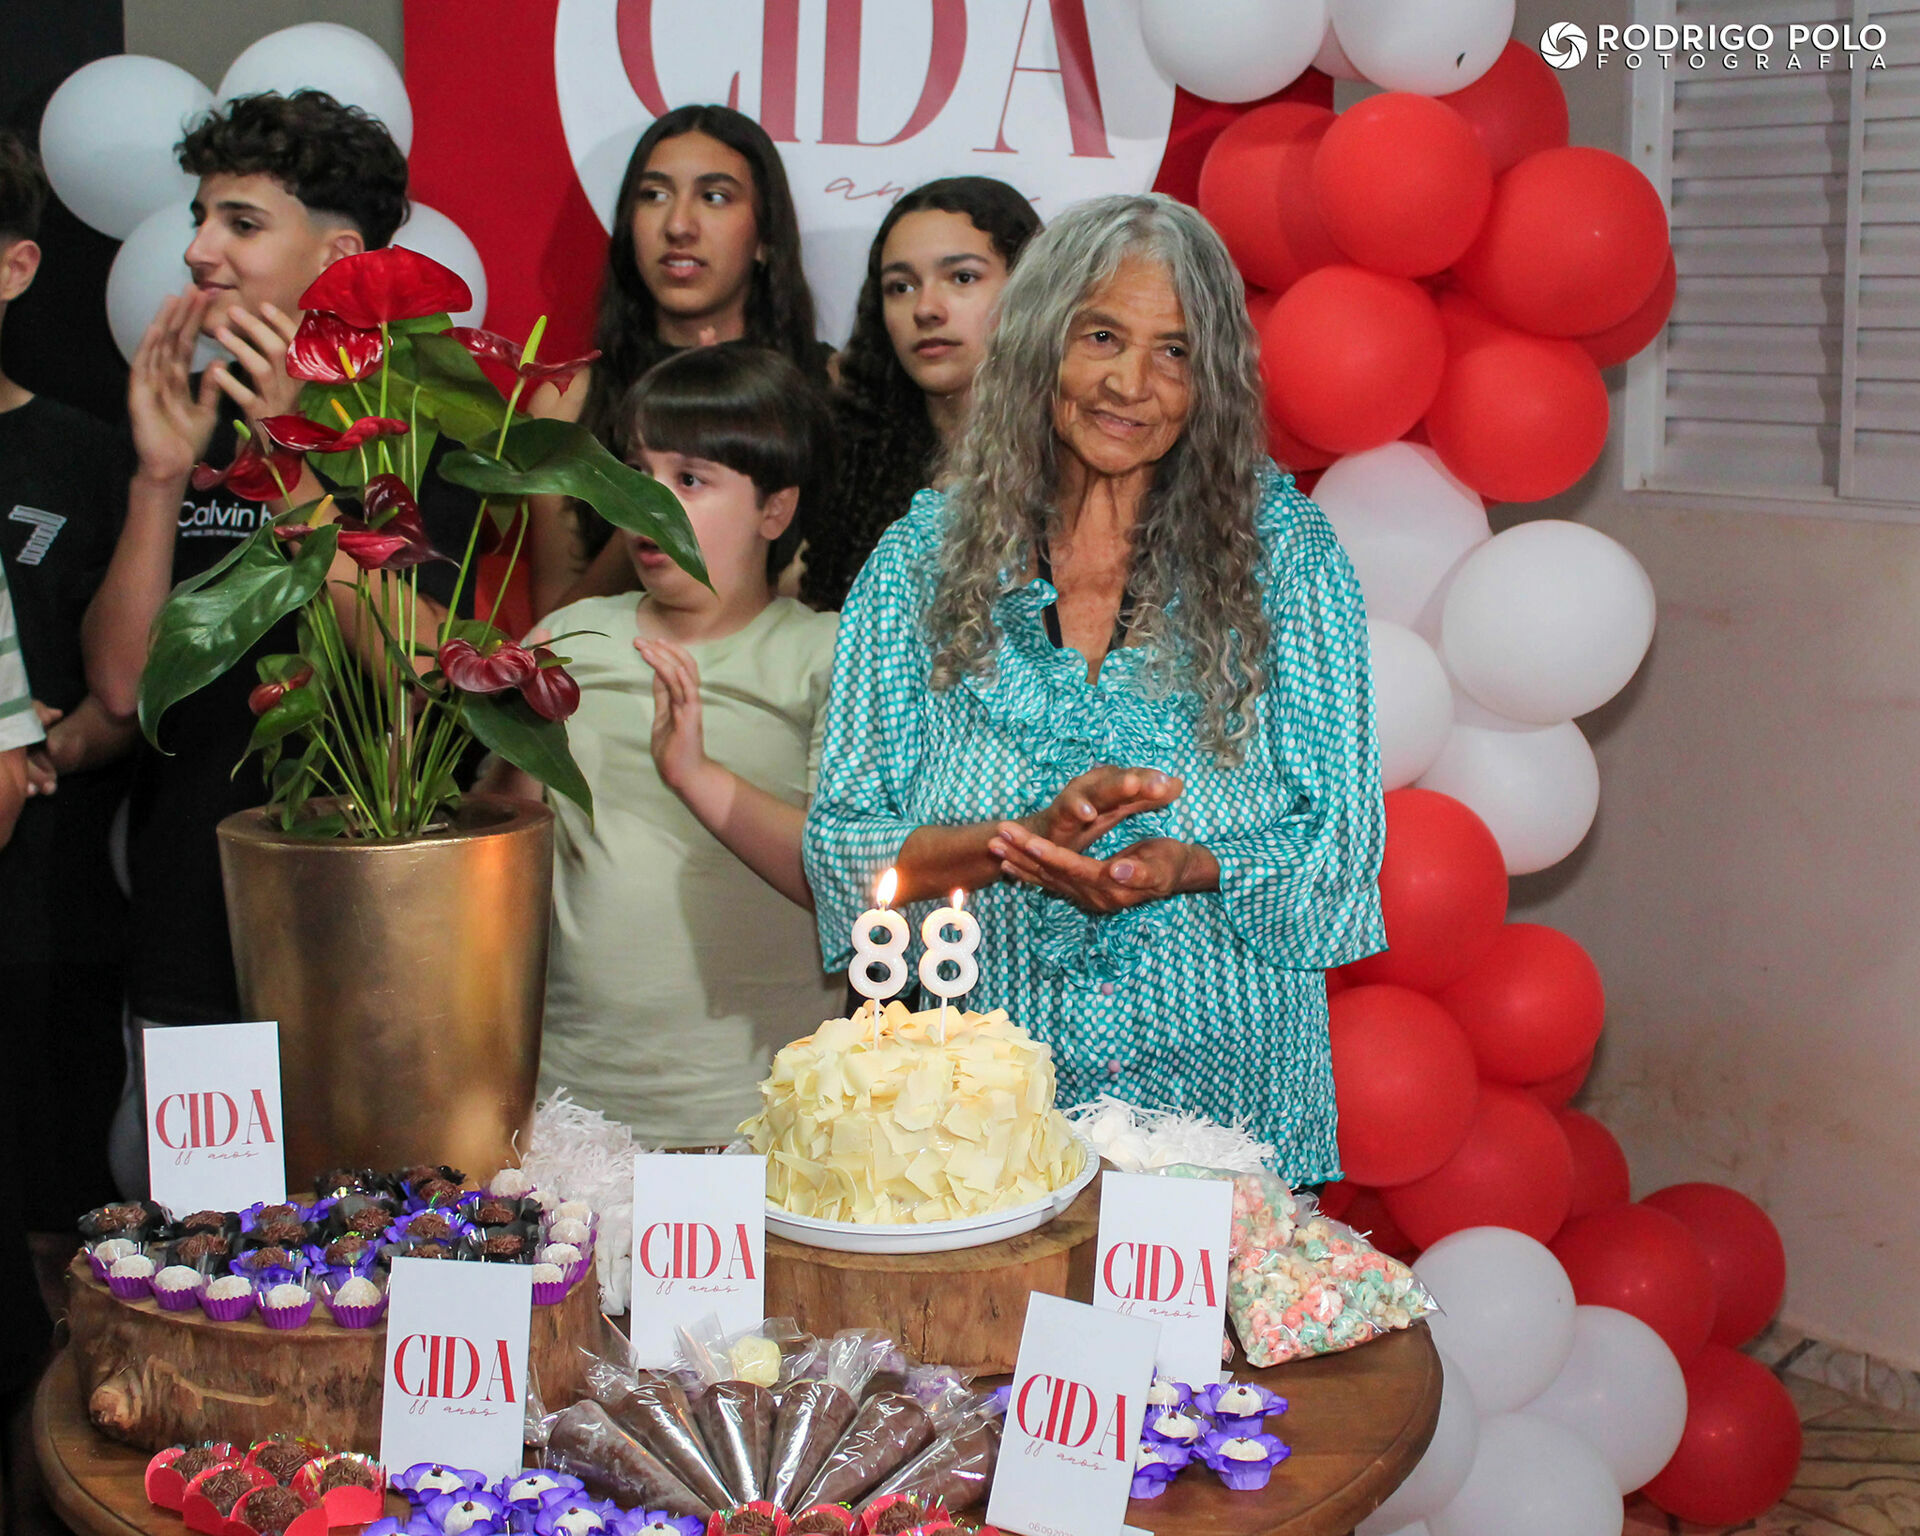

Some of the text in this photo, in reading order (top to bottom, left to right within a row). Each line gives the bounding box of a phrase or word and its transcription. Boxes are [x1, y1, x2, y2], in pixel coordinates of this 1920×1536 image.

[178, 499, 255, 528] Calvin
[155, 1088, 276, 1150] CIDA
[639, 1222, 757, 1280] CIDA
[1103, 1241, 1217, 1308] CIDA
[393, 1333, 517, 1404] CIDA
[1016, 1372, 1127, 1463] CIDA
